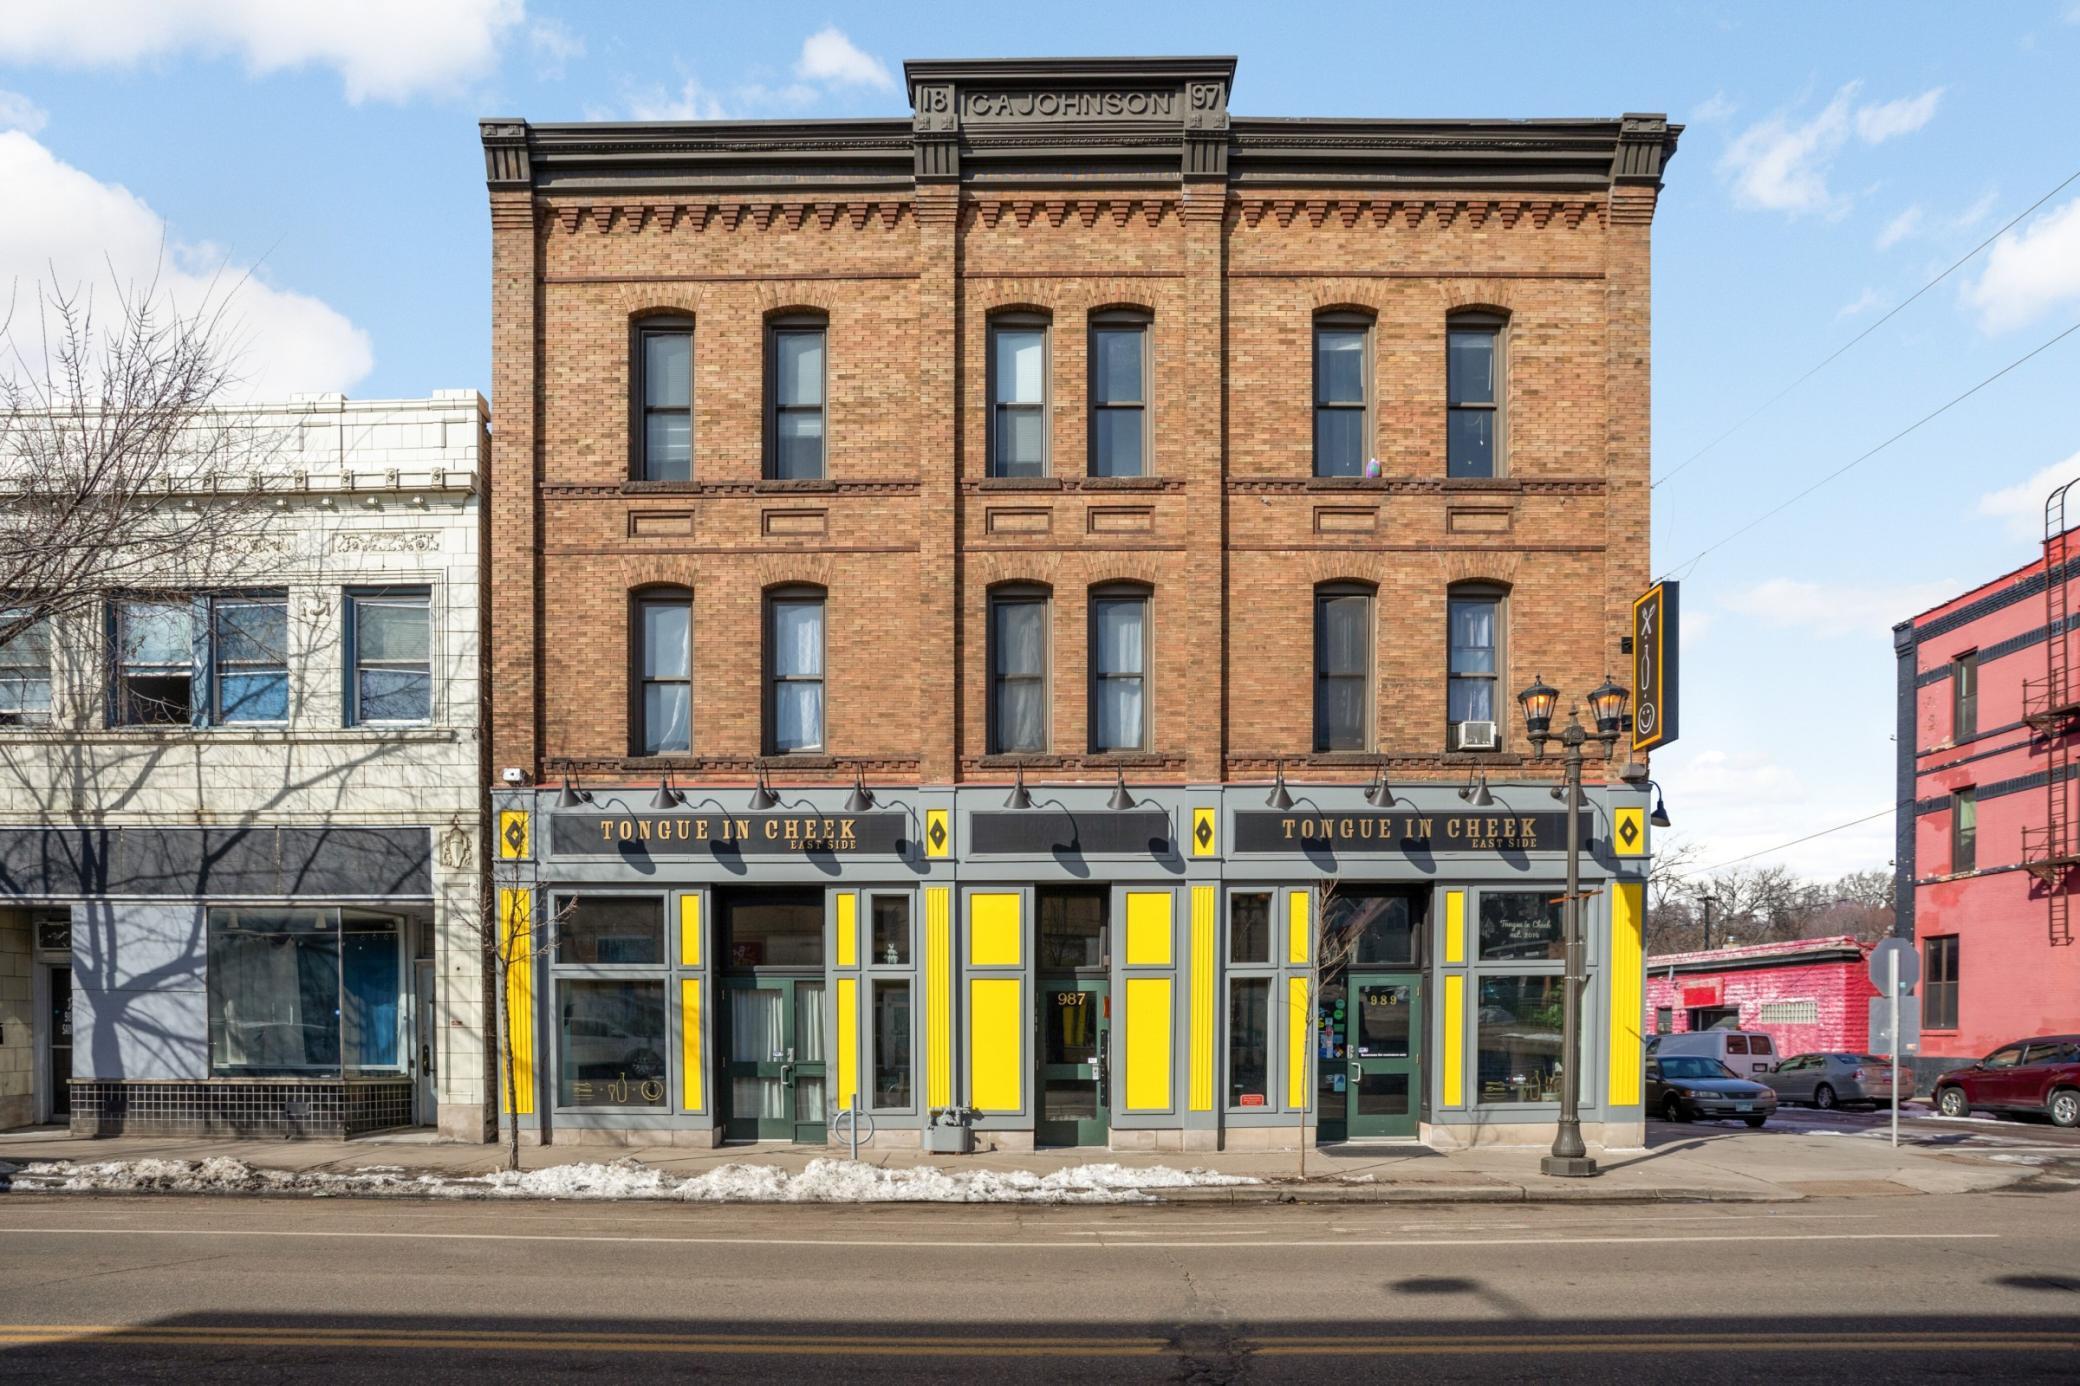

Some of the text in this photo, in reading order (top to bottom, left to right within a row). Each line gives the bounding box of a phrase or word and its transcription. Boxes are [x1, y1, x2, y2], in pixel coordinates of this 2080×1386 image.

[923, 86, 948, 113] 18
[1192, 84, 1220, 111] 97
[600, 819, 857, 840] TONGUE IN CHEEK
[1282, 818, 1537, 839] TONGUE IN CHEEK
[790, 840, 857, 850] EAST SIDE
[1472, 838, 1537, 848] EAST SIDE
[1058, 992, 1086, 1005] 987
[1370, 994, 1397, 1005] 989
